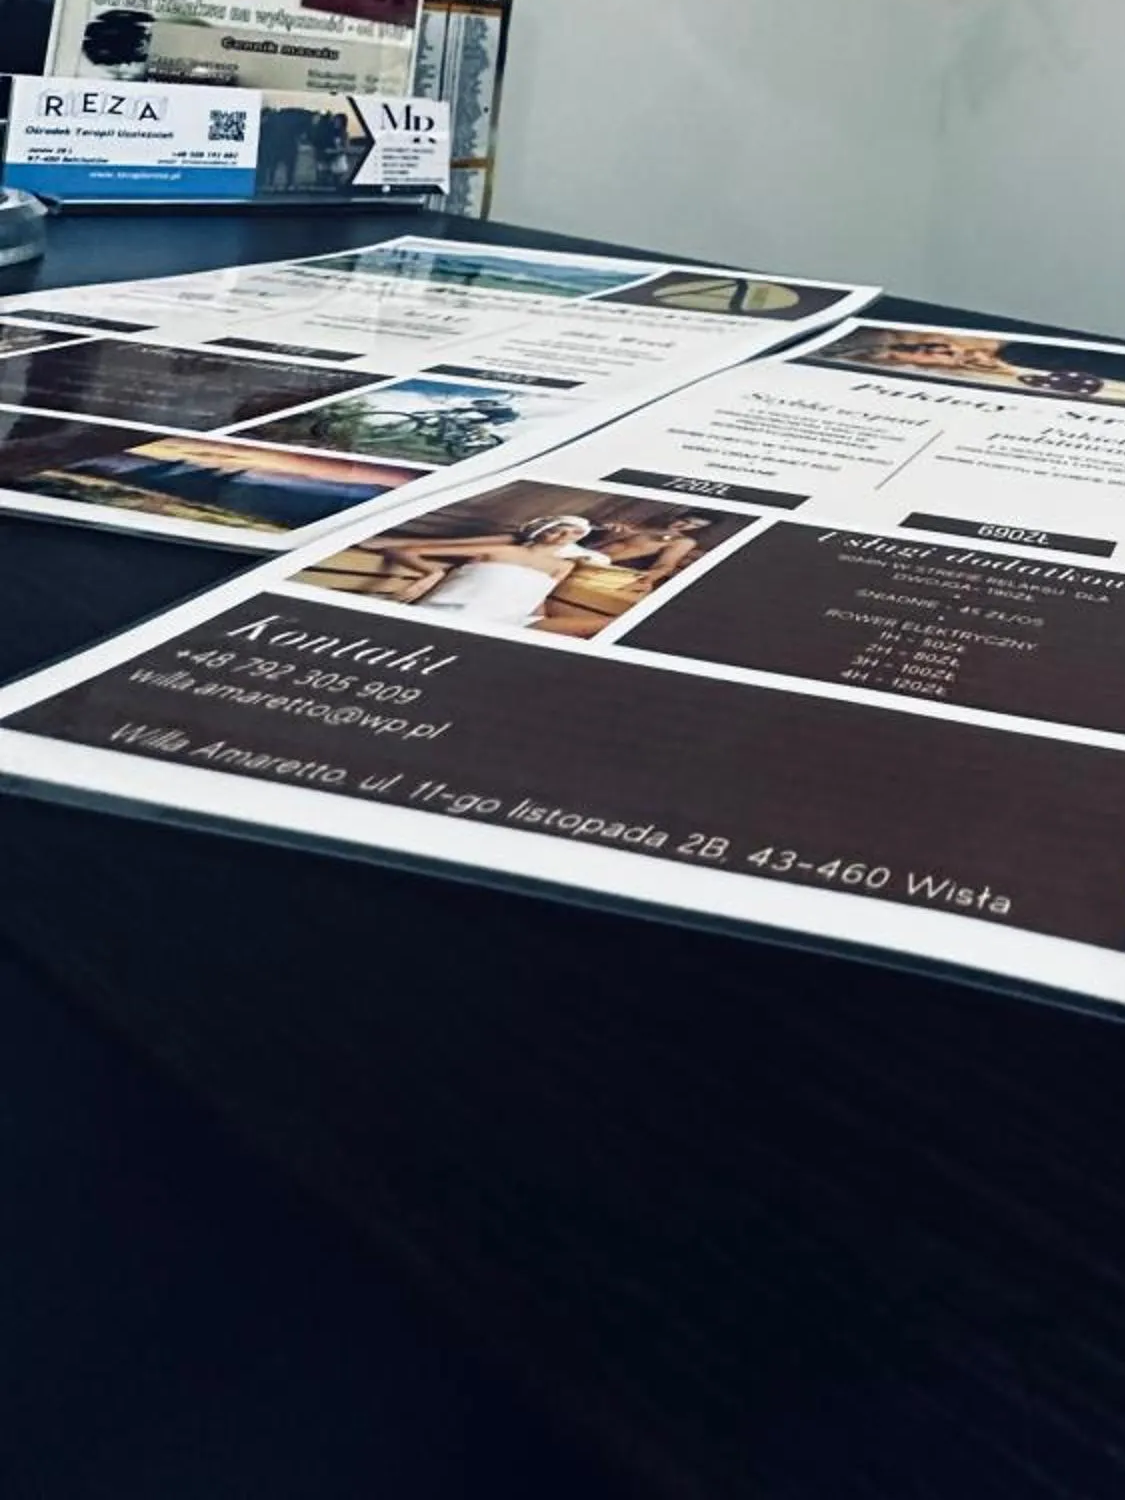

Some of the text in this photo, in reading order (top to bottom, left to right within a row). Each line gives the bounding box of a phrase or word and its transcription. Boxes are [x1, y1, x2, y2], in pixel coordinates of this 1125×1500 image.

[44, 92, 161, 121] REZA
[227, 613, 461, 676] Kontakt
[825, 607, 1040, 652] ROWER ELEKTRYCZNY
[229, 657, 296, 681] 792
[293, 668, 359, 693] 305
[355, 680, 422, 707] 909
[109, 721, 192, 754] Willa
[506, 783, 670, 850] listopada
[745, 846, 892, 890] 43-460
[906, 871, 1013, 916] Wisła
